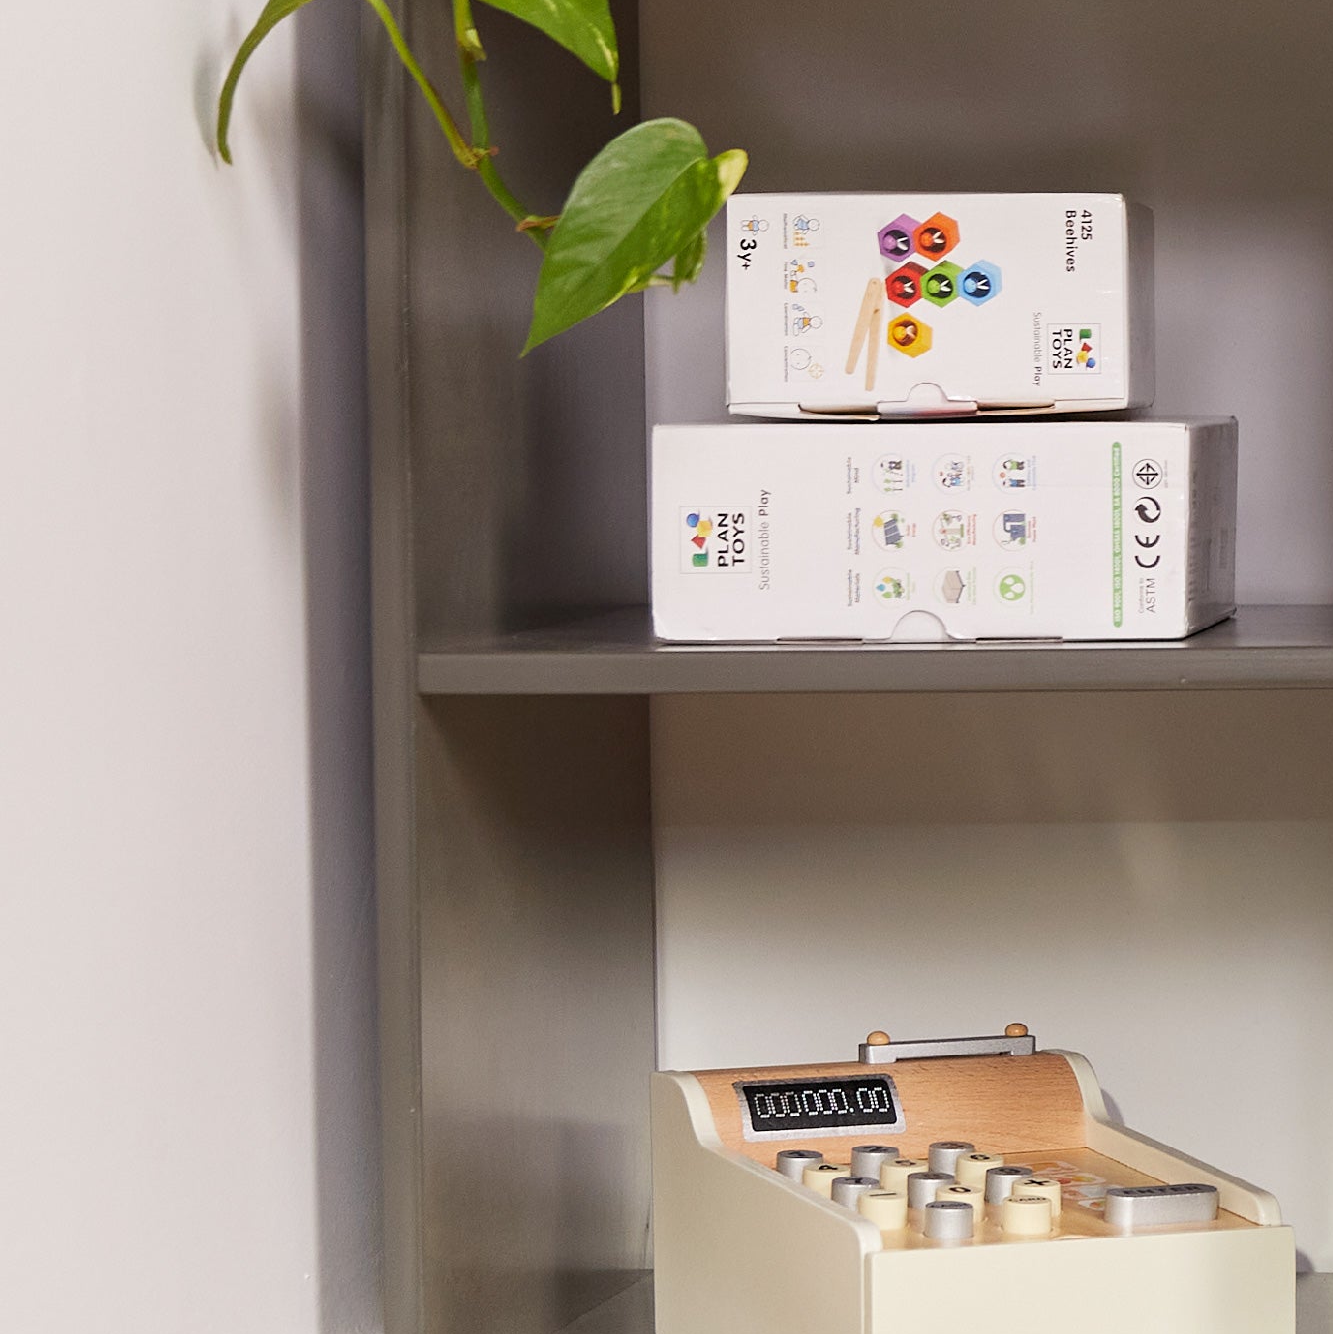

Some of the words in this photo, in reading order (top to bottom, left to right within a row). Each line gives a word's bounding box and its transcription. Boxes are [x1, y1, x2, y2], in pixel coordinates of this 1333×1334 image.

[1066, 210, 1077, 272] Beehives
[1082, 210, 1092, 239] 4125
[1034, 312, 1042, 362] Sustainable
[1053, 329, 1062, 368] TOYS
[1064, 329, 1072, 368] PLAN
[1032, 366, 1042, 386] Play
[759, 489, 771, 516] Play
[717, 513, 729, 567] PLAN
[732, 513, 744, 566] TOYS
[758, 522, 770, 590] Sustainable
[1146, 578, 1155, 612] ASTM
